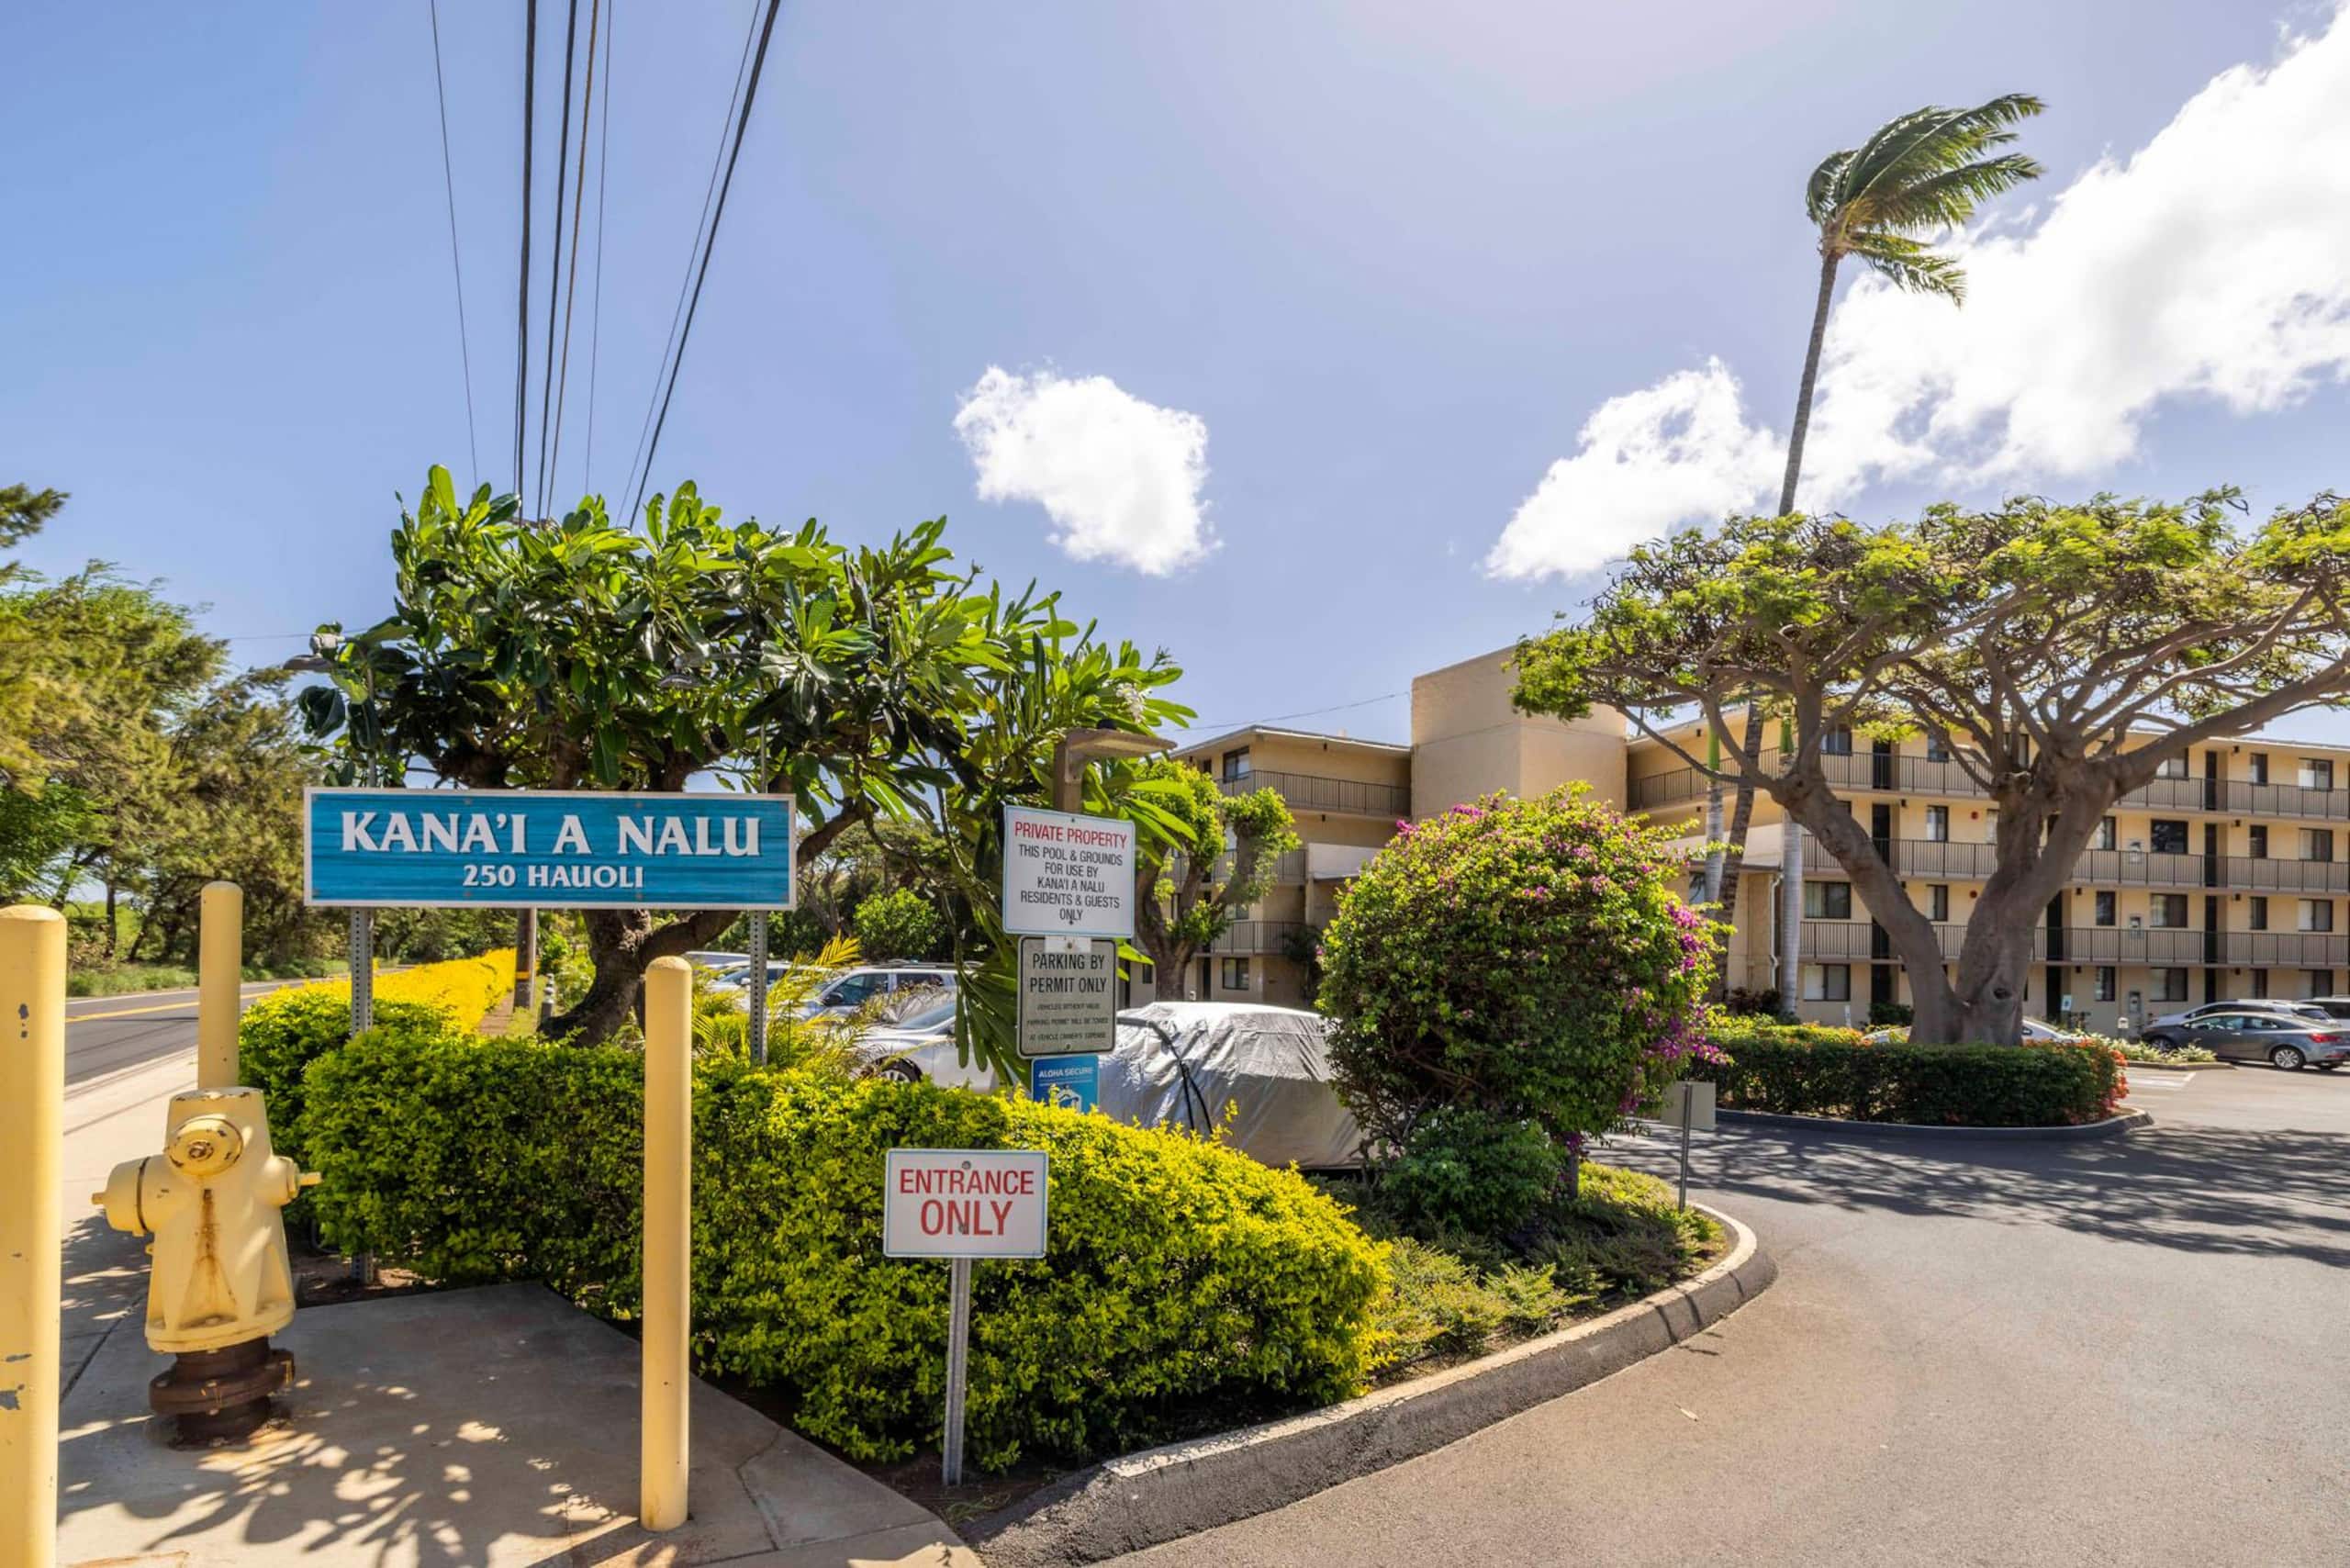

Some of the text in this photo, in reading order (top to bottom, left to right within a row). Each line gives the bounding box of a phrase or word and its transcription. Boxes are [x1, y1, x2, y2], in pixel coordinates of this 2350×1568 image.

[341, 811, 762, 857] KANA'I A NALU
[1014, 821, 1127, 849] PRIVATE PROPERTY
[1018, 844, 1124, 867] THIS POOL & GROUNDS
[462, 864, 643, 889] 250 HAUOLI
[1045, 862, 1099, 879] FOR USE BY
[1070, 879, 1079, 891] A
[1080, 879, 1105, 893] NALU
[1021, 890, 1120, 909] RESIDENTS & GUESTS
[1059, 908, 1083, 921] ONLY
[1032, 953, 1105, 970] PARKING BY
[1029, 977, 1107, 993] PERMIT ONLY
[1038, 1069, 1064, 1078] ALOHA
[900, 1169, 1035, 1195] ENTRANCE
[920, 1199, 1013, 1237] ONLY
